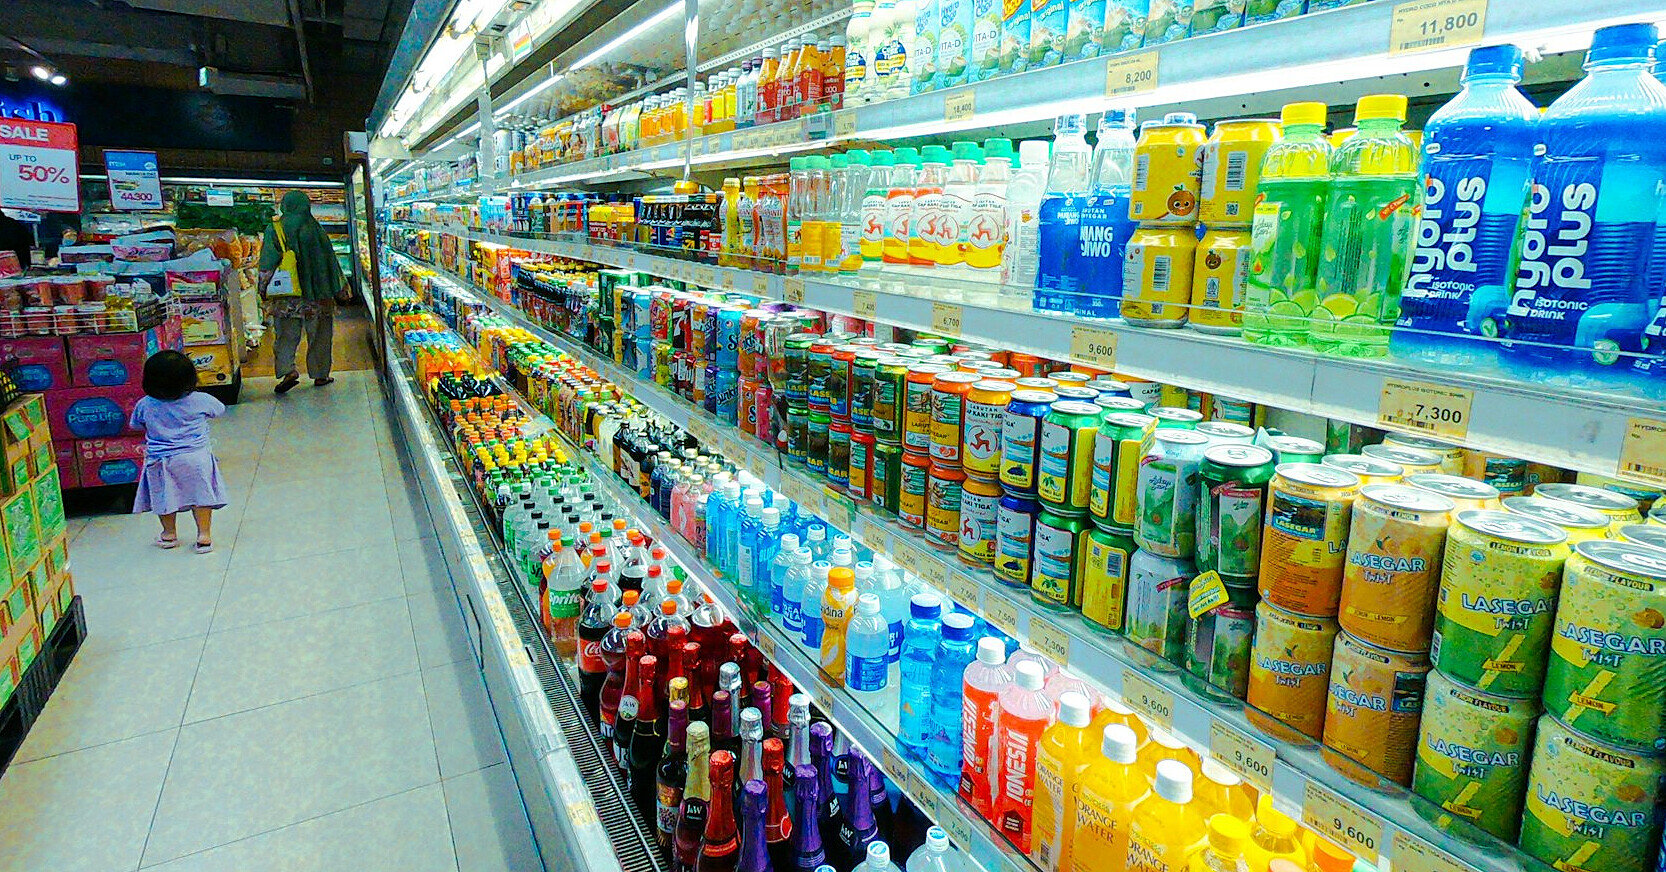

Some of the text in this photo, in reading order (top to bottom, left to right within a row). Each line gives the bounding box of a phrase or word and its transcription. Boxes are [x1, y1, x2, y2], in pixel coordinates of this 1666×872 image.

[1420, 12, 1478, 35] 11,800
[941, 40, 961, 50] ITA-D
[975, 31, 997, 42] ITA-D
[1125, 70, 1152, 84] 8,200
[0, 124, 50, 142] SALE
[9, 153, 37, 163] UP TO
[18, 164, 70, 184] 50%
[1443, 176, 1486, 272] plus
[1547, 182, 1597, 290] plus
[1431, 281, 1475, 292] ISOTONIC
[1534, 296, 1590, 312] ISOTONIC
[1529, 308, 1566, 321] DRINK
[1088, 343, 1113, 357] 9,600
[1416, 404, 1462, 424] 7,300
[1611, 574, 1651, 591] FLAVOUR
[821, 605, 843, 618] dina
[1461, 593, 1554, 616] LASEGA
[997, 610, 1016, 626] 7,500
[1044, 636, 1066, 655] 7,300
[1142, 695, 1169, 717] 9,600
[1474, 699, 1508, 713] FLAVOUR
[1577, 695, 1605, 711] LEMON
[1427, 732, 1521, 768] LASEGAR
[1594, 748, 1633, 768] FLAVOUR
[1036, 761, 1064, 786] ORANGE
[1235, 750, 1269, 777] 9,600
[1037, 771, 1063, 796] WATER
[1076, 799, 1118, 830] ORANGE
[1537, 783, 1648, 828] LASEGAR
[1075, 810, 1116, 844] WATER
[1333, 817, 1375, 851] 9,600
